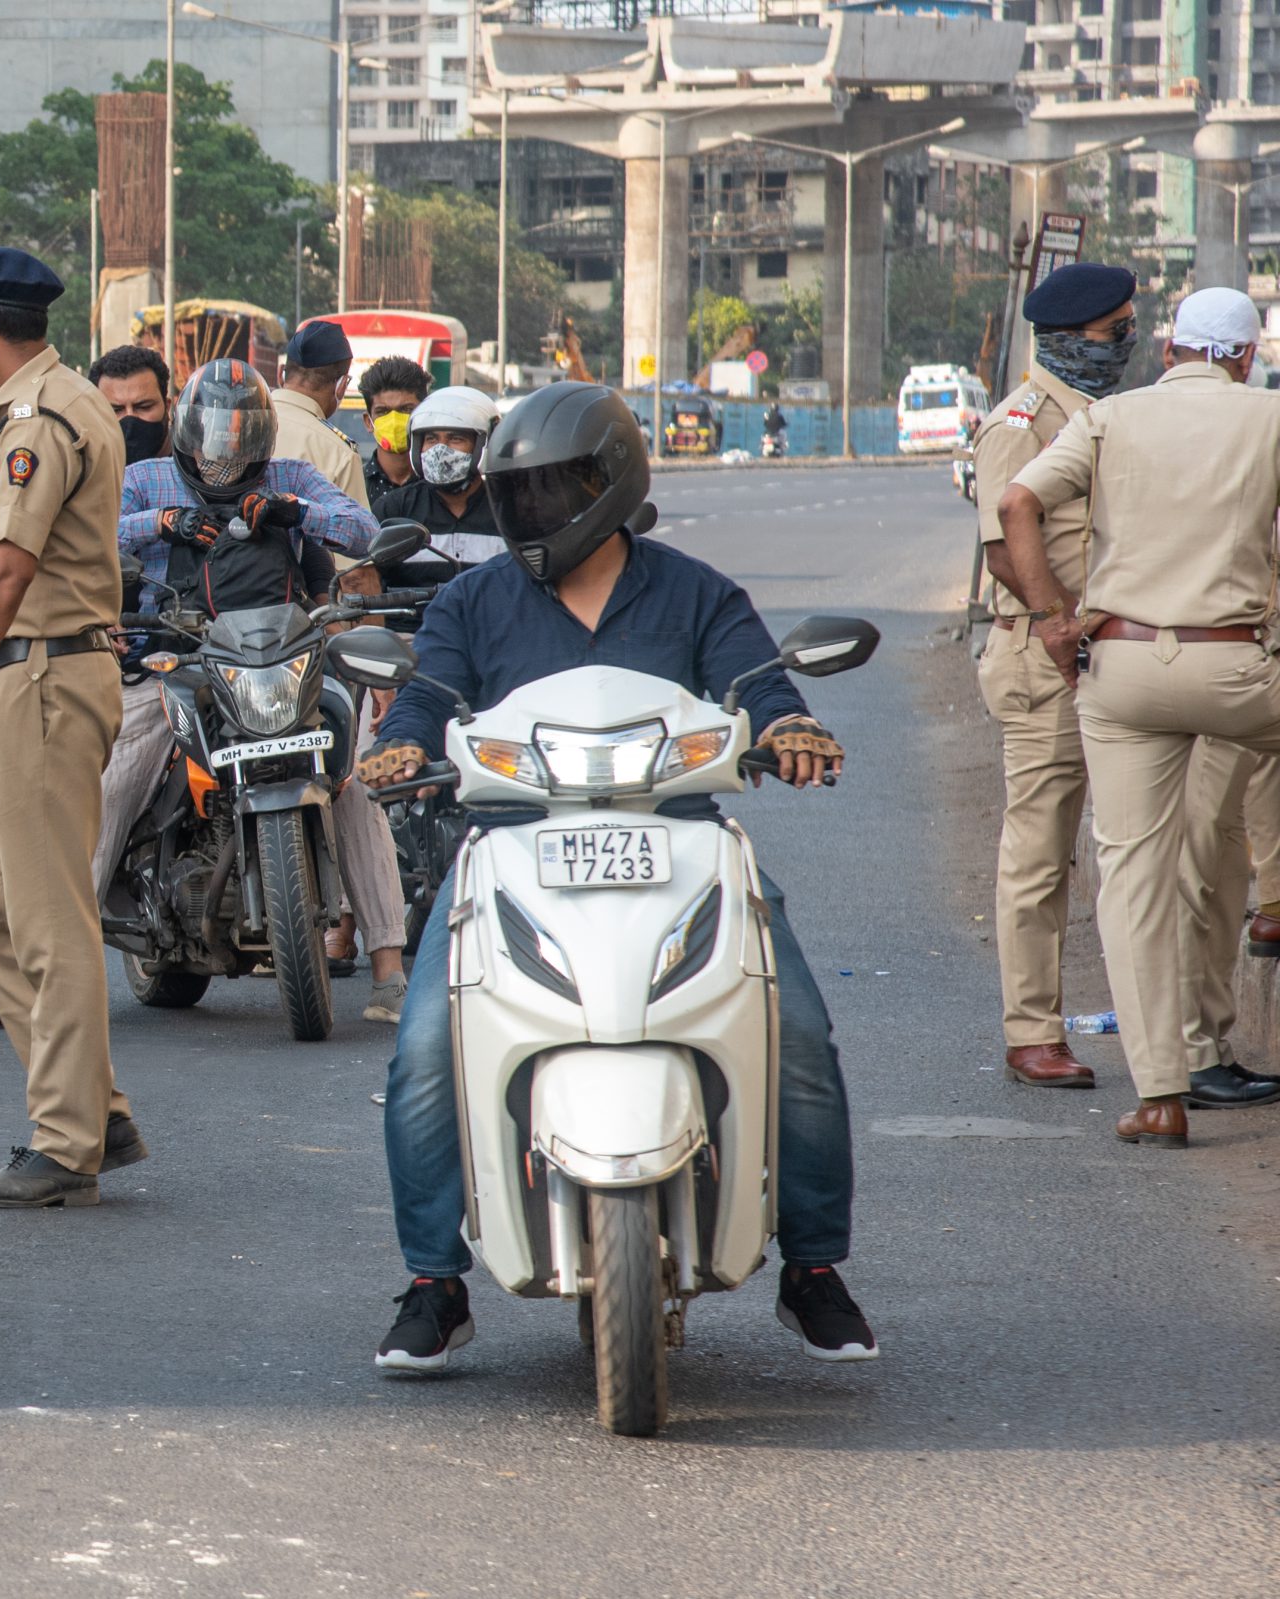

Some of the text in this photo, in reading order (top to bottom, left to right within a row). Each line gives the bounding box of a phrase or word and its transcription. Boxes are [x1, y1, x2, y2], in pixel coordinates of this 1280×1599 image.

[222, 749, 241, 761] MH
[298, 736, 330, 748] 2387
[563, 857, 654, 882] T7433
